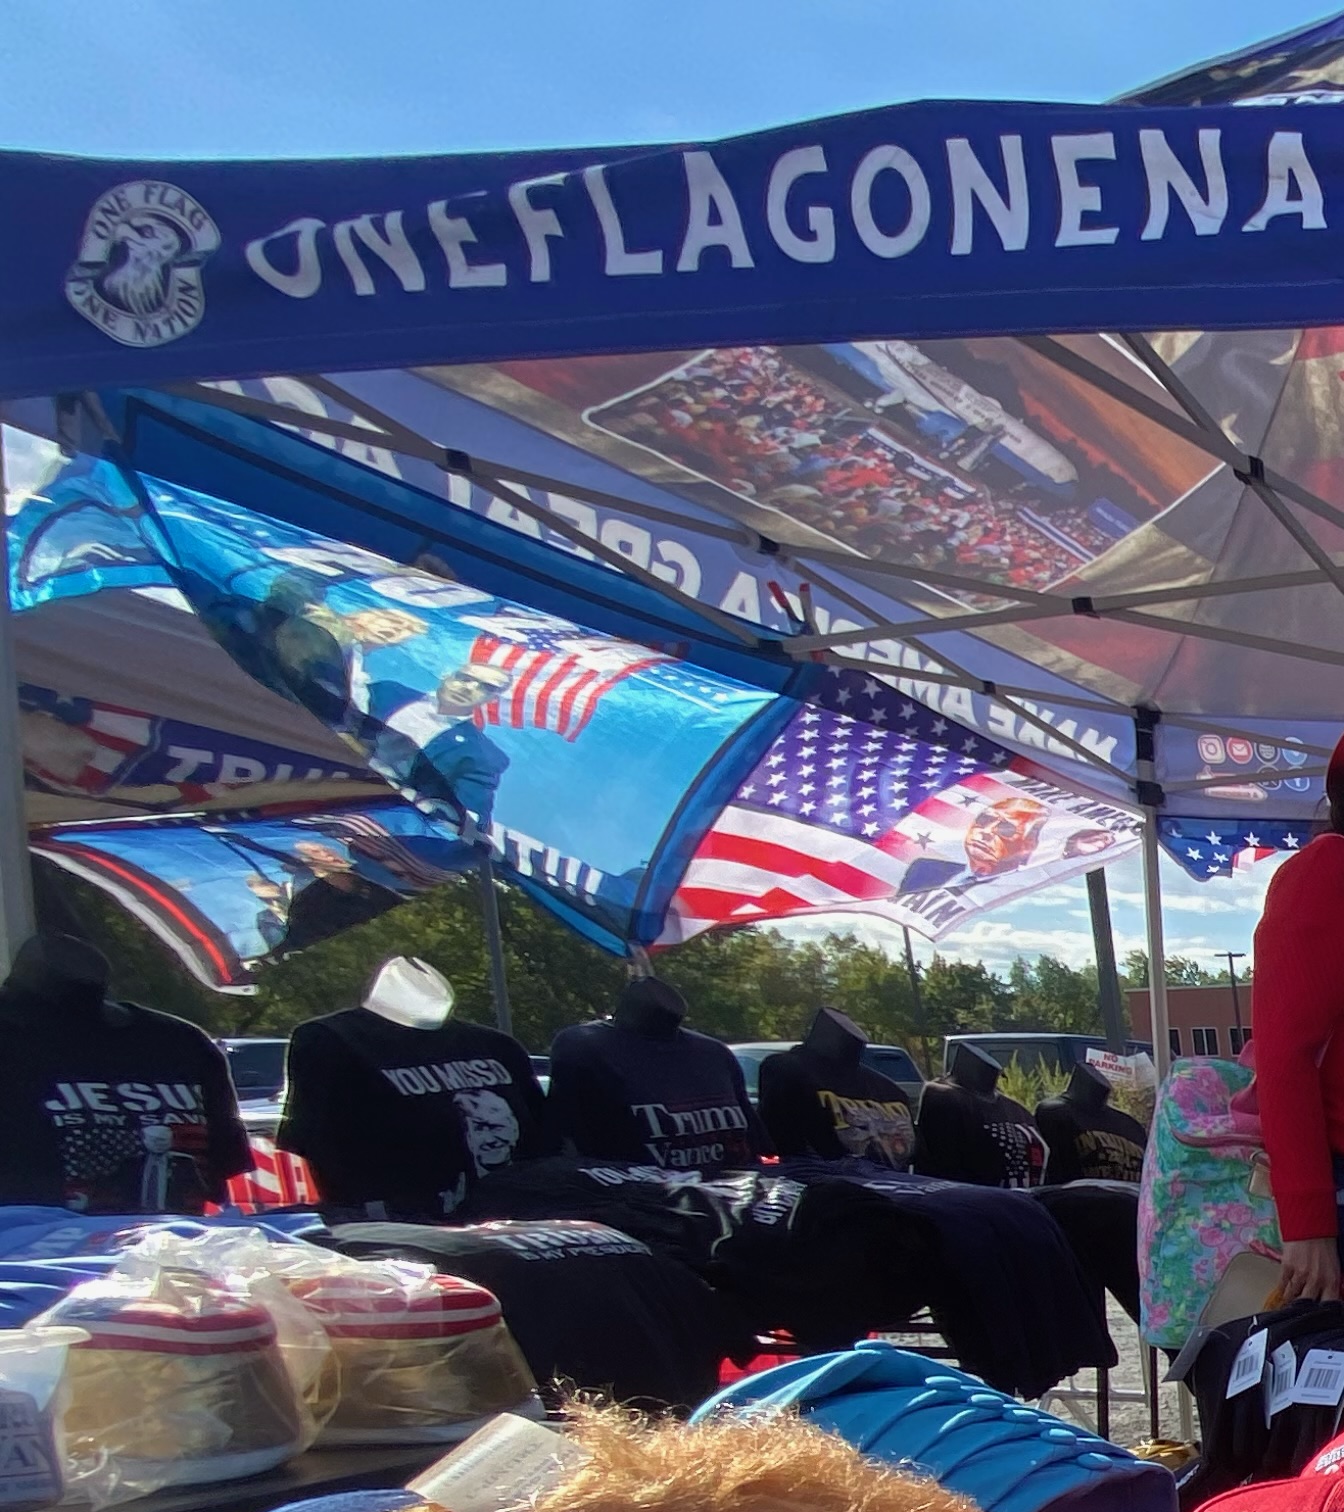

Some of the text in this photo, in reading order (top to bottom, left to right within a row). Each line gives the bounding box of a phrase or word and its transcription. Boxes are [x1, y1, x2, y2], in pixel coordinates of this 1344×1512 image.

[93, 184, 208, 240] ONE FLAG
[1103, 1053, 1118, 1063] NO
[1089, 1059, 1133, 1076] PARKING
[382, 1065, 434, 1096] YOU
[54, 1112, 207, 1127] IS MY SAV
